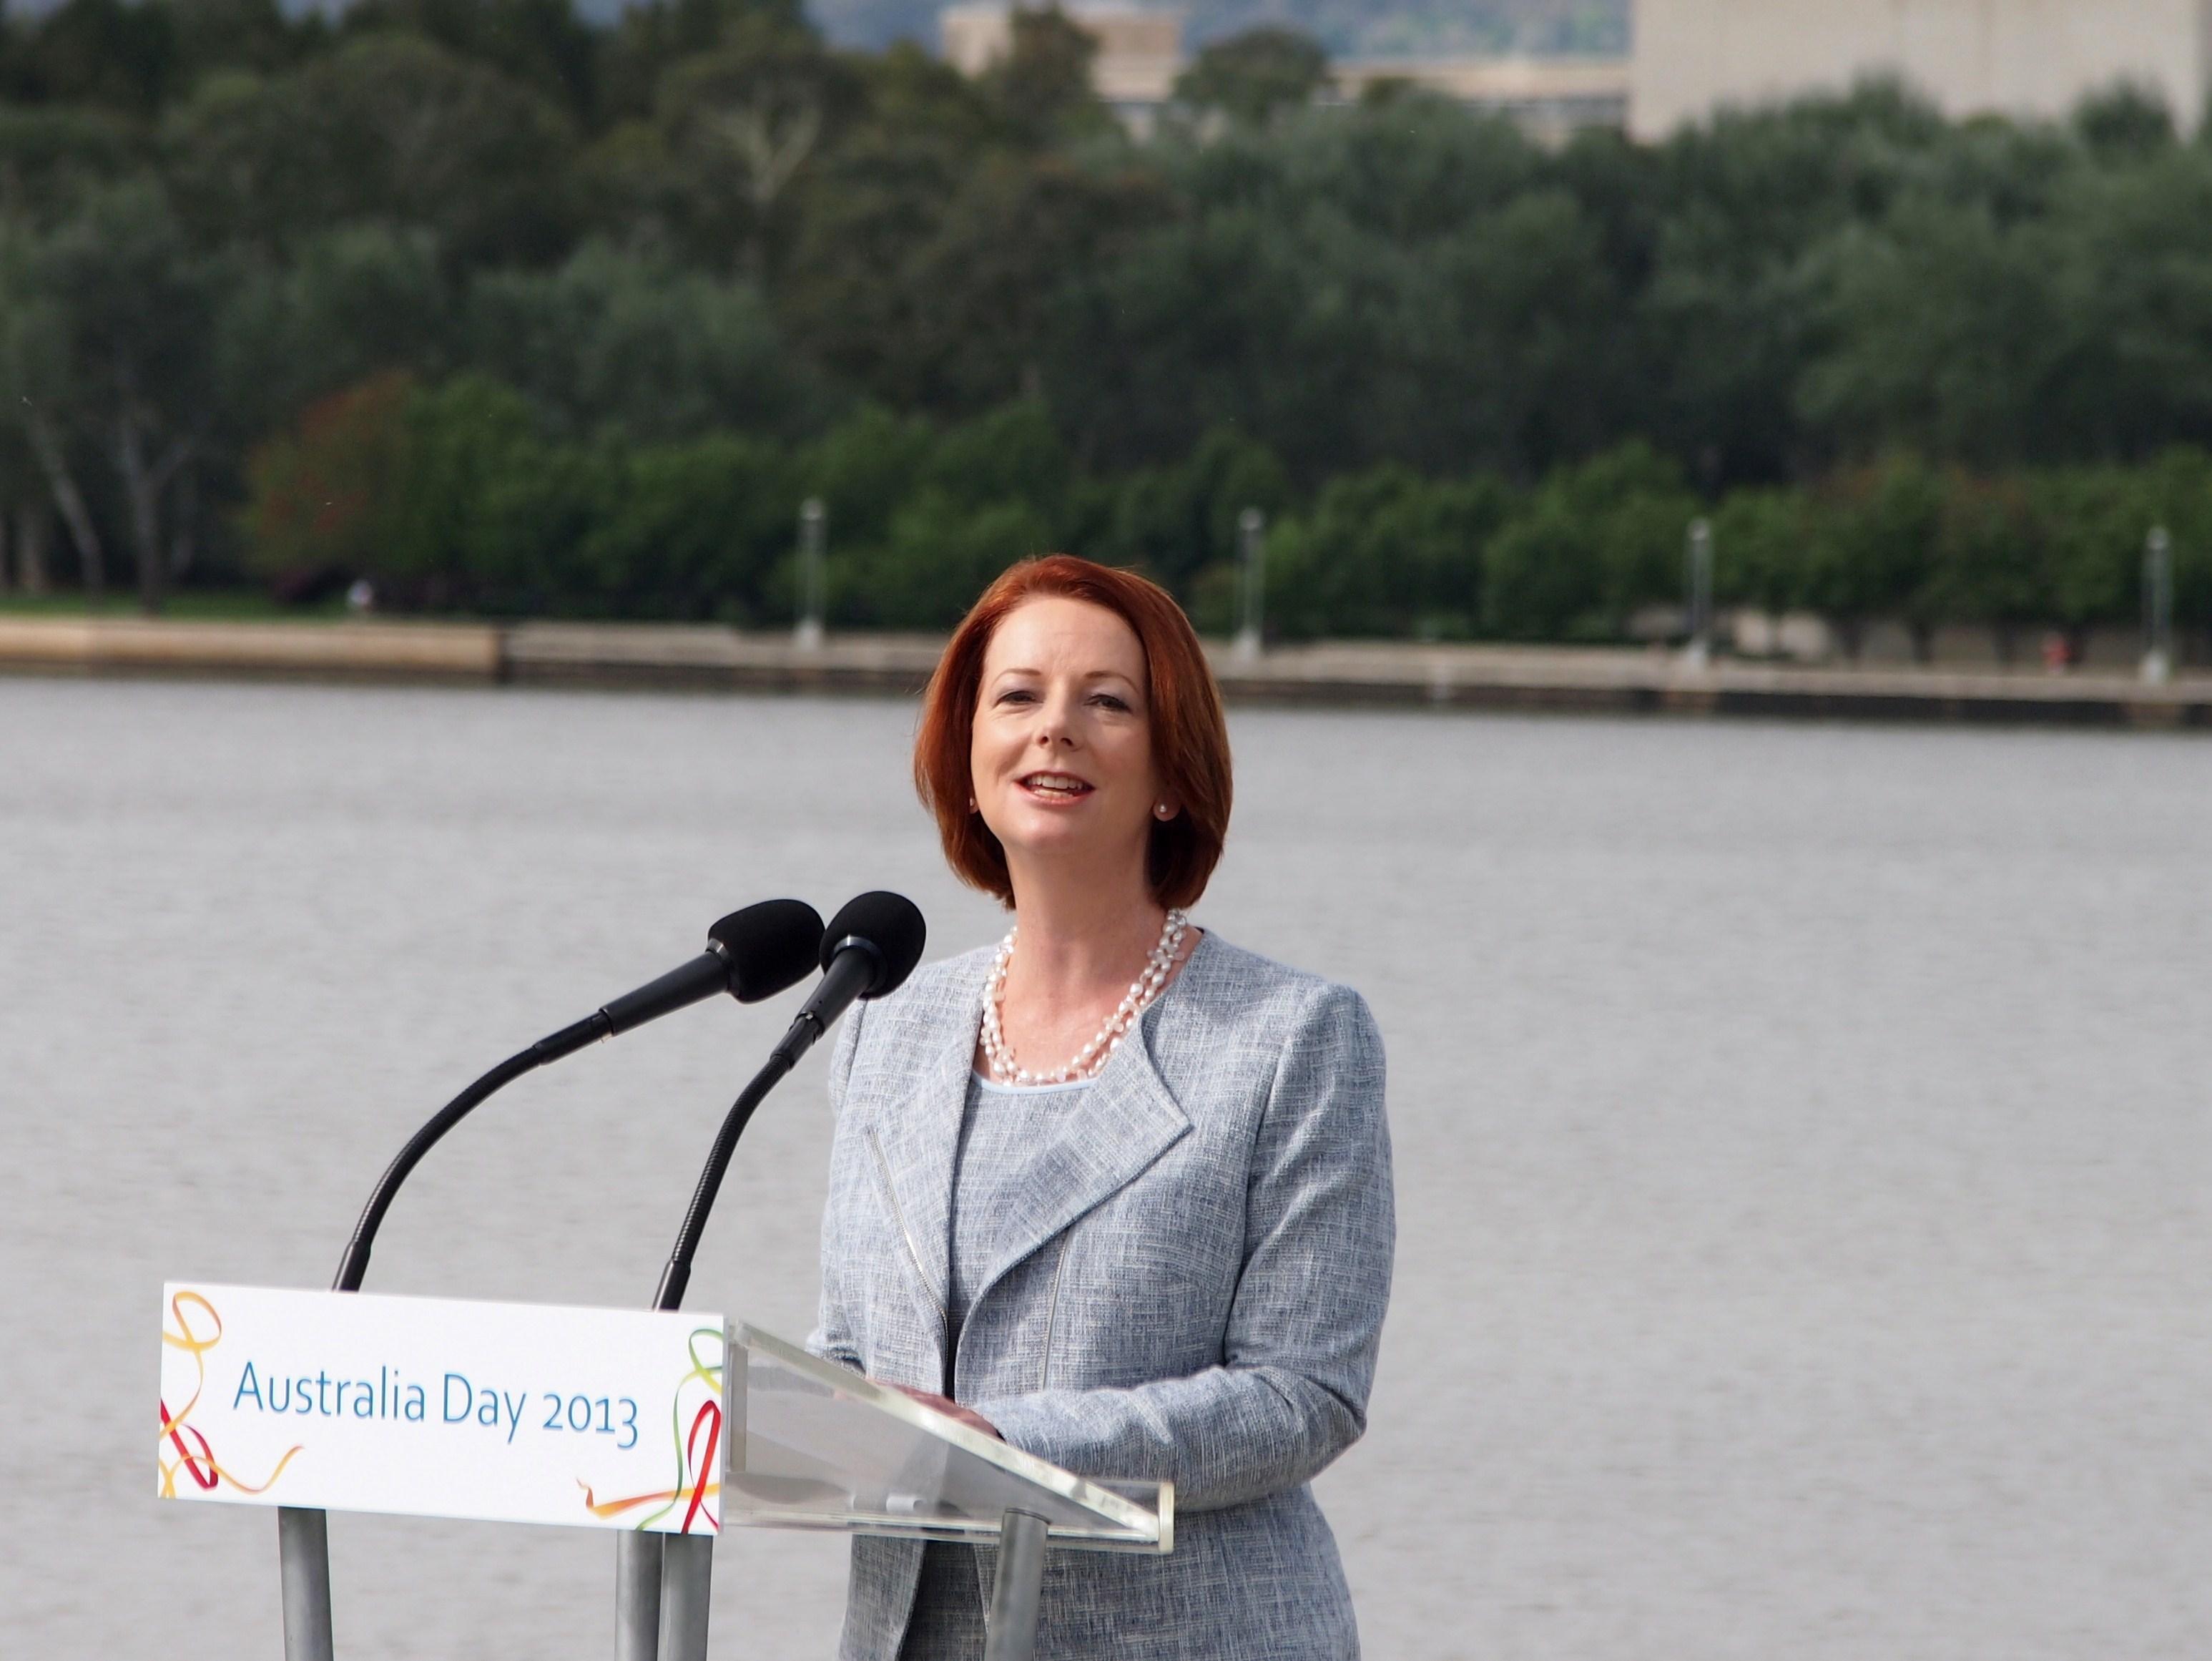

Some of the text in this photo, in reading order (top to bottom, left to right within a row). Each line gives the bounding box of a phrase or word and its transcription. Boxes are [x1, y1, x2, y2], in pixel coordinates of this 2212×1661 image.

[233, 1361, 639, 1450] Australia Day 2013
